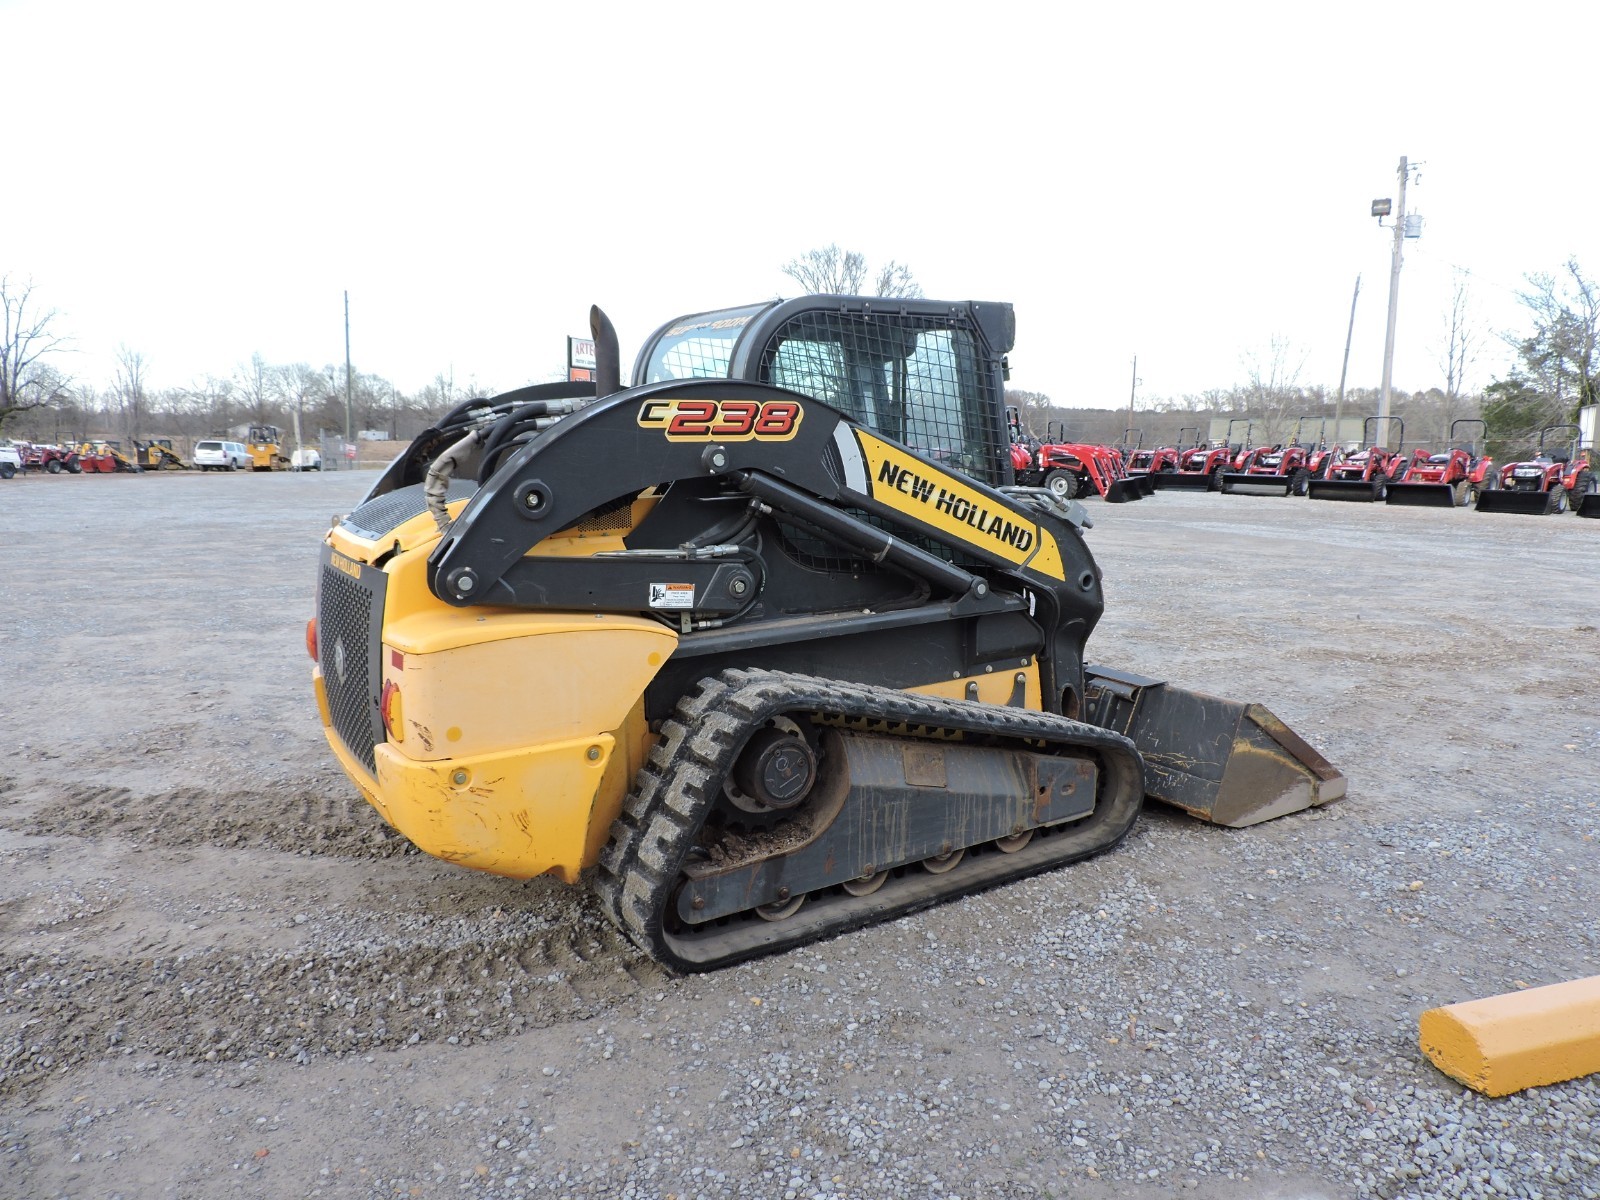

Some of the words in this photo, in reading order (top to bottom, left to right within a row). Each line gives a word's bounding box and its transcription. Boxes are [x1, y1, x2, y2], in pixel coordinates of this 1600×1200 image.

[638, 400, 803, 441] C238
[877, 459, 936, 504] NEW
[935, 488, 1033, 552] HOLLAND
